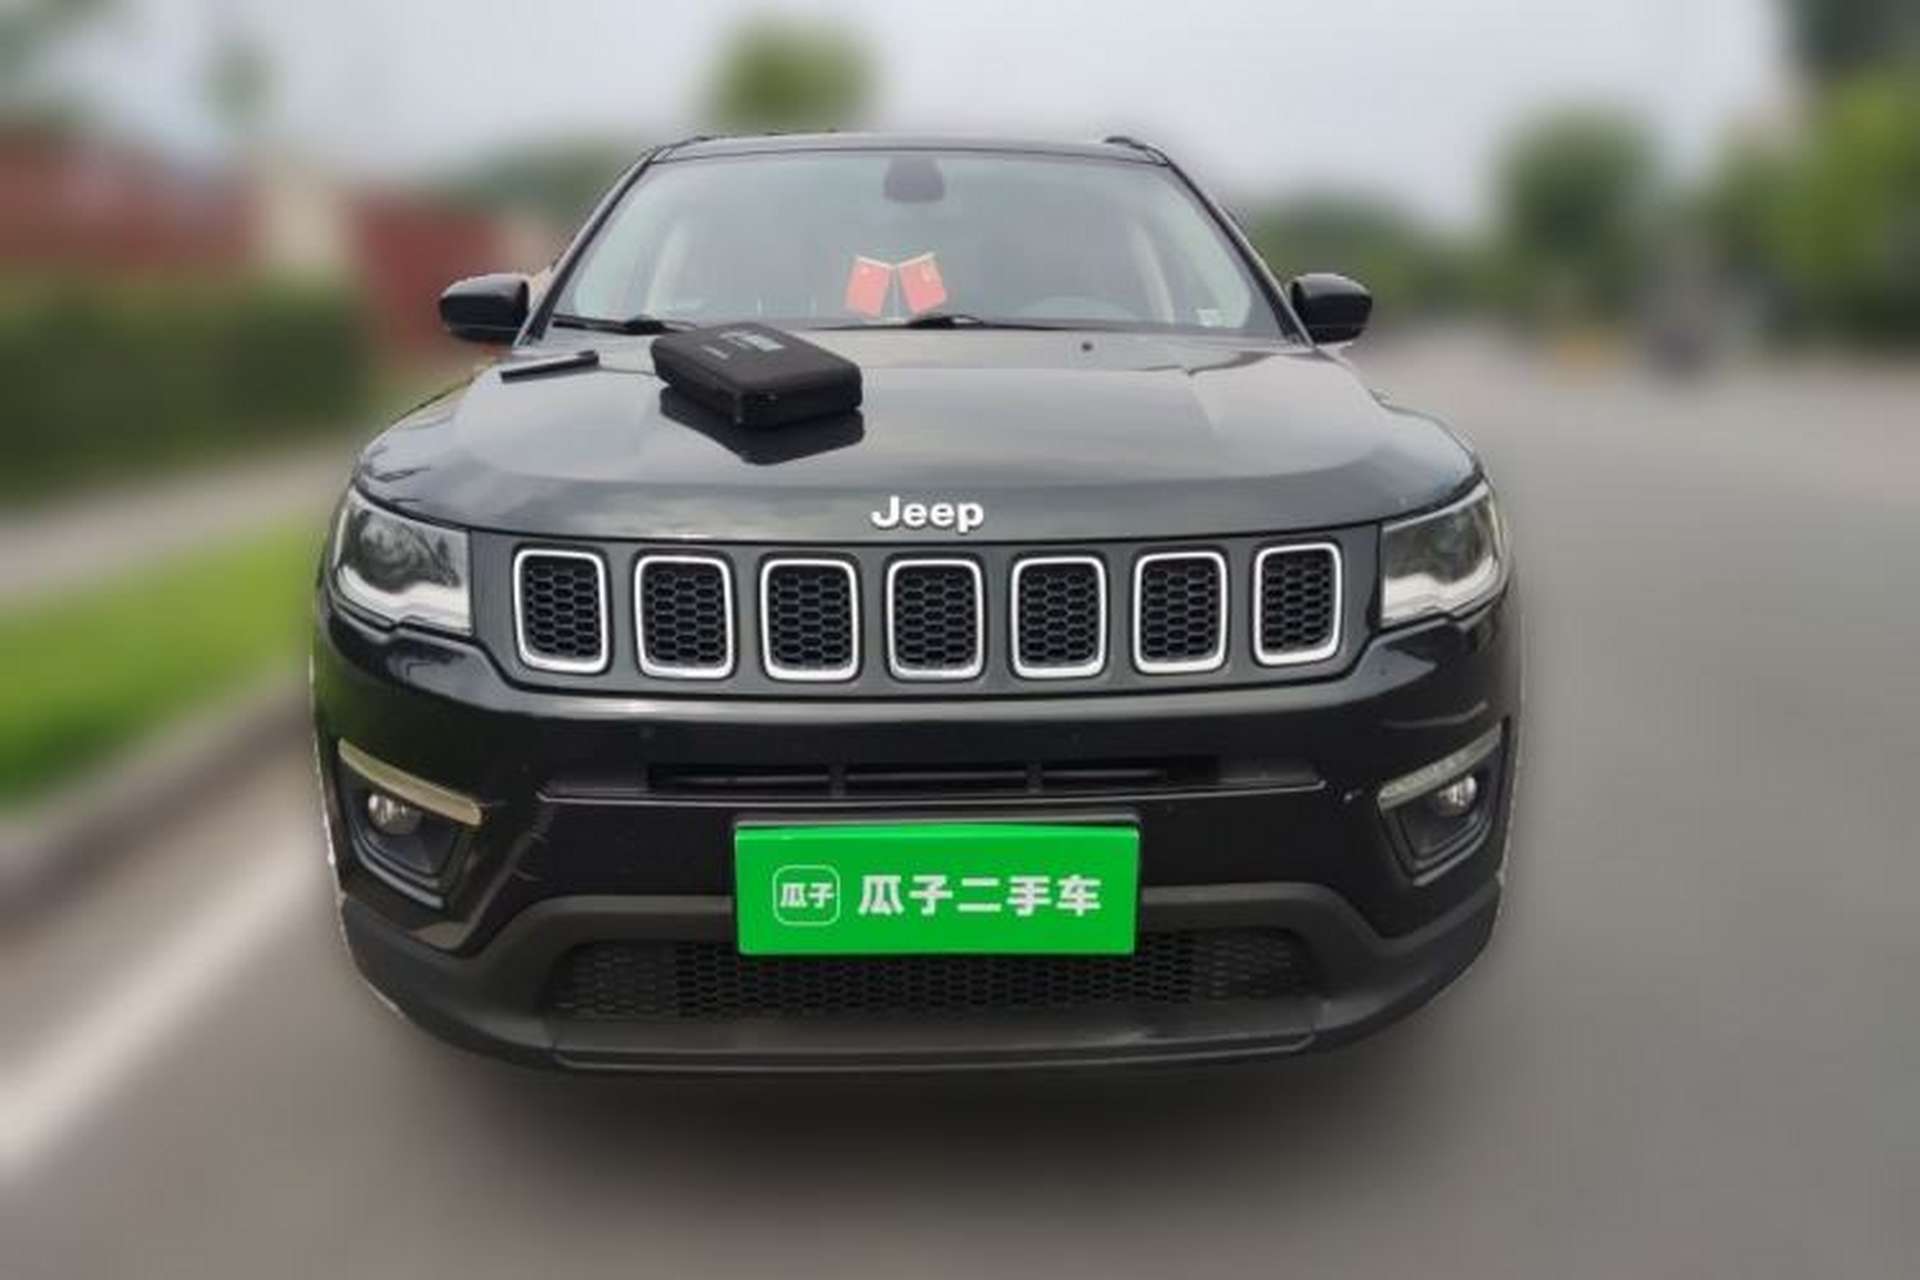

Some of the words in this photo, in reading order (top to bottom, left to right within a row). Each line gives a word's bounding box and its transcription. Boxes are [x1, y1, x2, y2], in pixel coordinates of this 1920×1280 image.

[870, 495, 984, 533] Jeep
[779, 882, 835, 909] 瓜子
[858, 874, 1102, 917] 瓜子二手车
